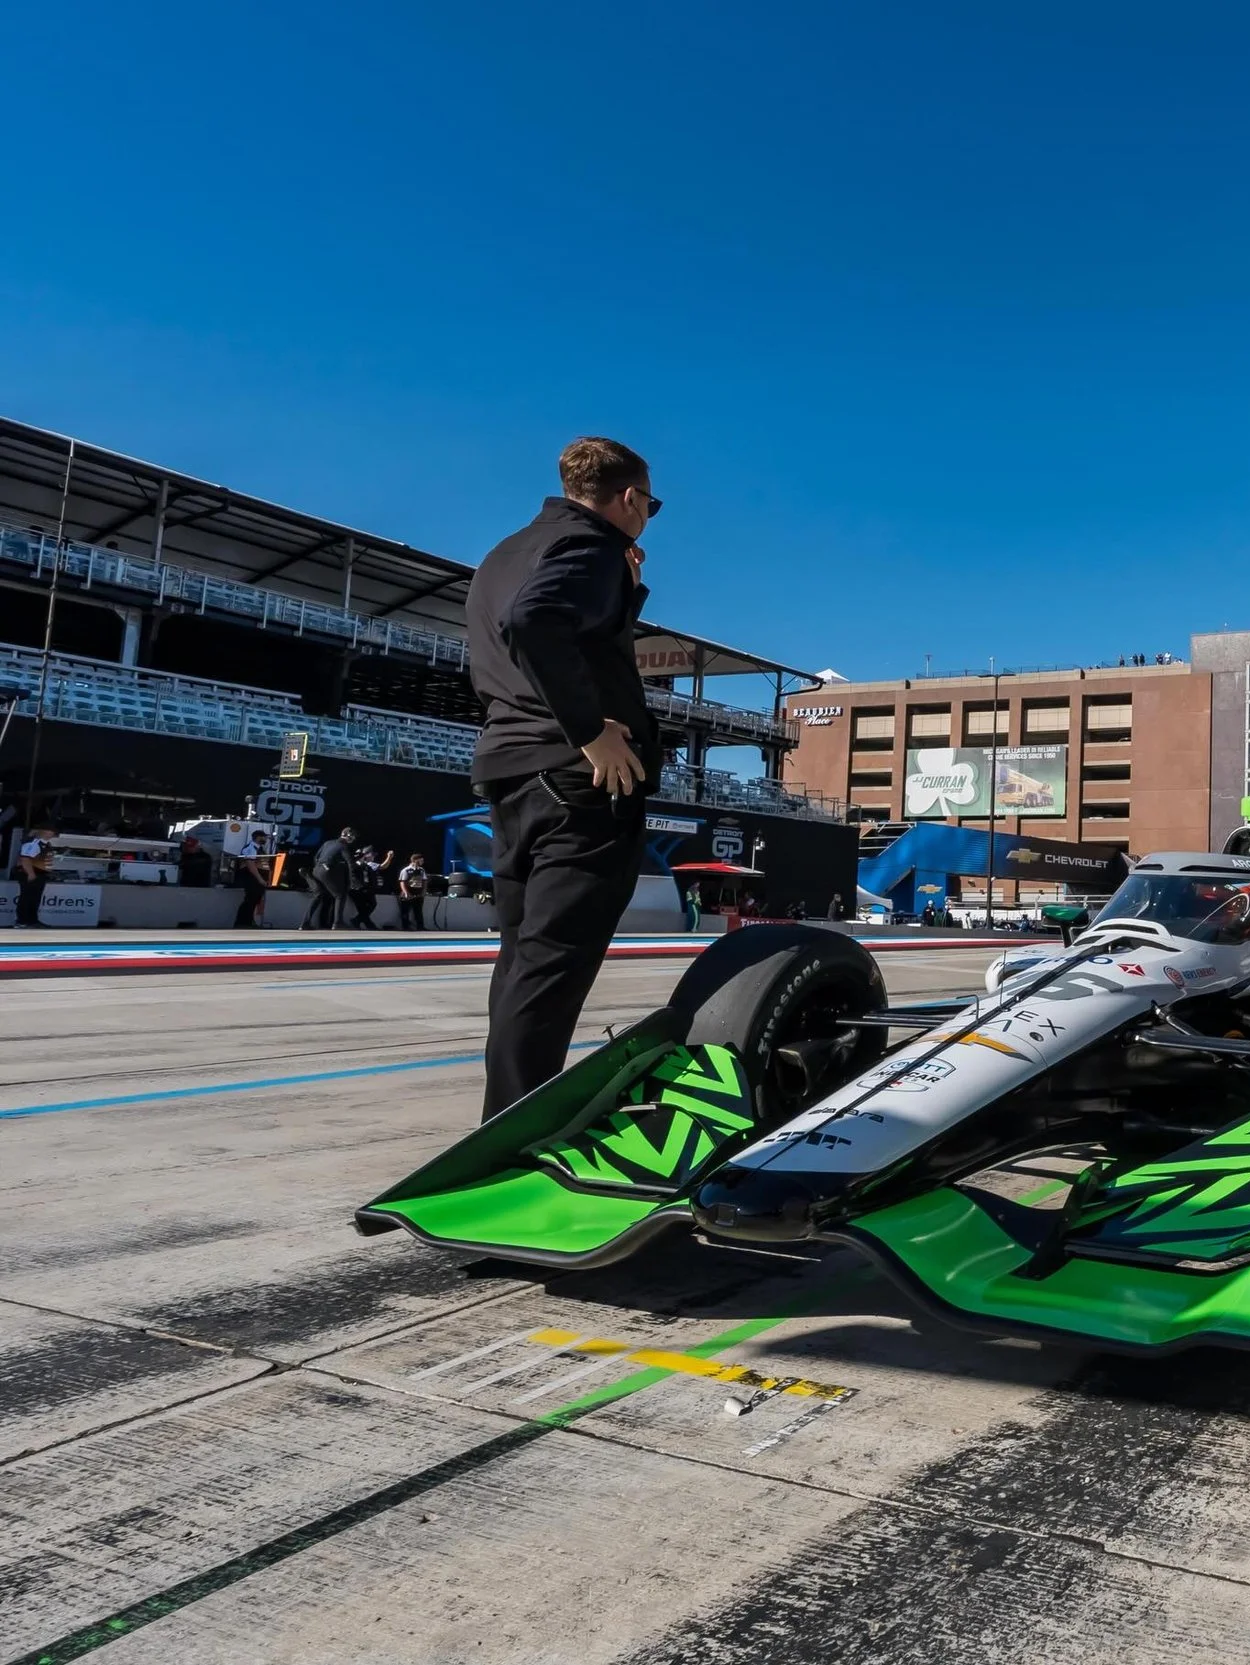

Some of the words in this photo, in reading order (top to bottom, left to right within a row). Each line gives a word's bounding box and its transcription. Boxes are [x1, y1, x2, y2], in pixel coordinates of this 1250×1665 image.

[793, 706, 842, 717] BEAUBIEN
[259, 779, 327, 795] DETROIT
[922, 775, 967, 789] CURRAN
[256, 790, 325, 824] GP
[655, 820, 670, 829] PIT
[712, 828, 744, 838] DETROIT
[712, 836, 744, 858] GP
[1044, 854, 1109, 869] CHEVROLET
[757, 959, 821, 1055] Firestone
[870, 1069, 941, 1084] INDCAR
